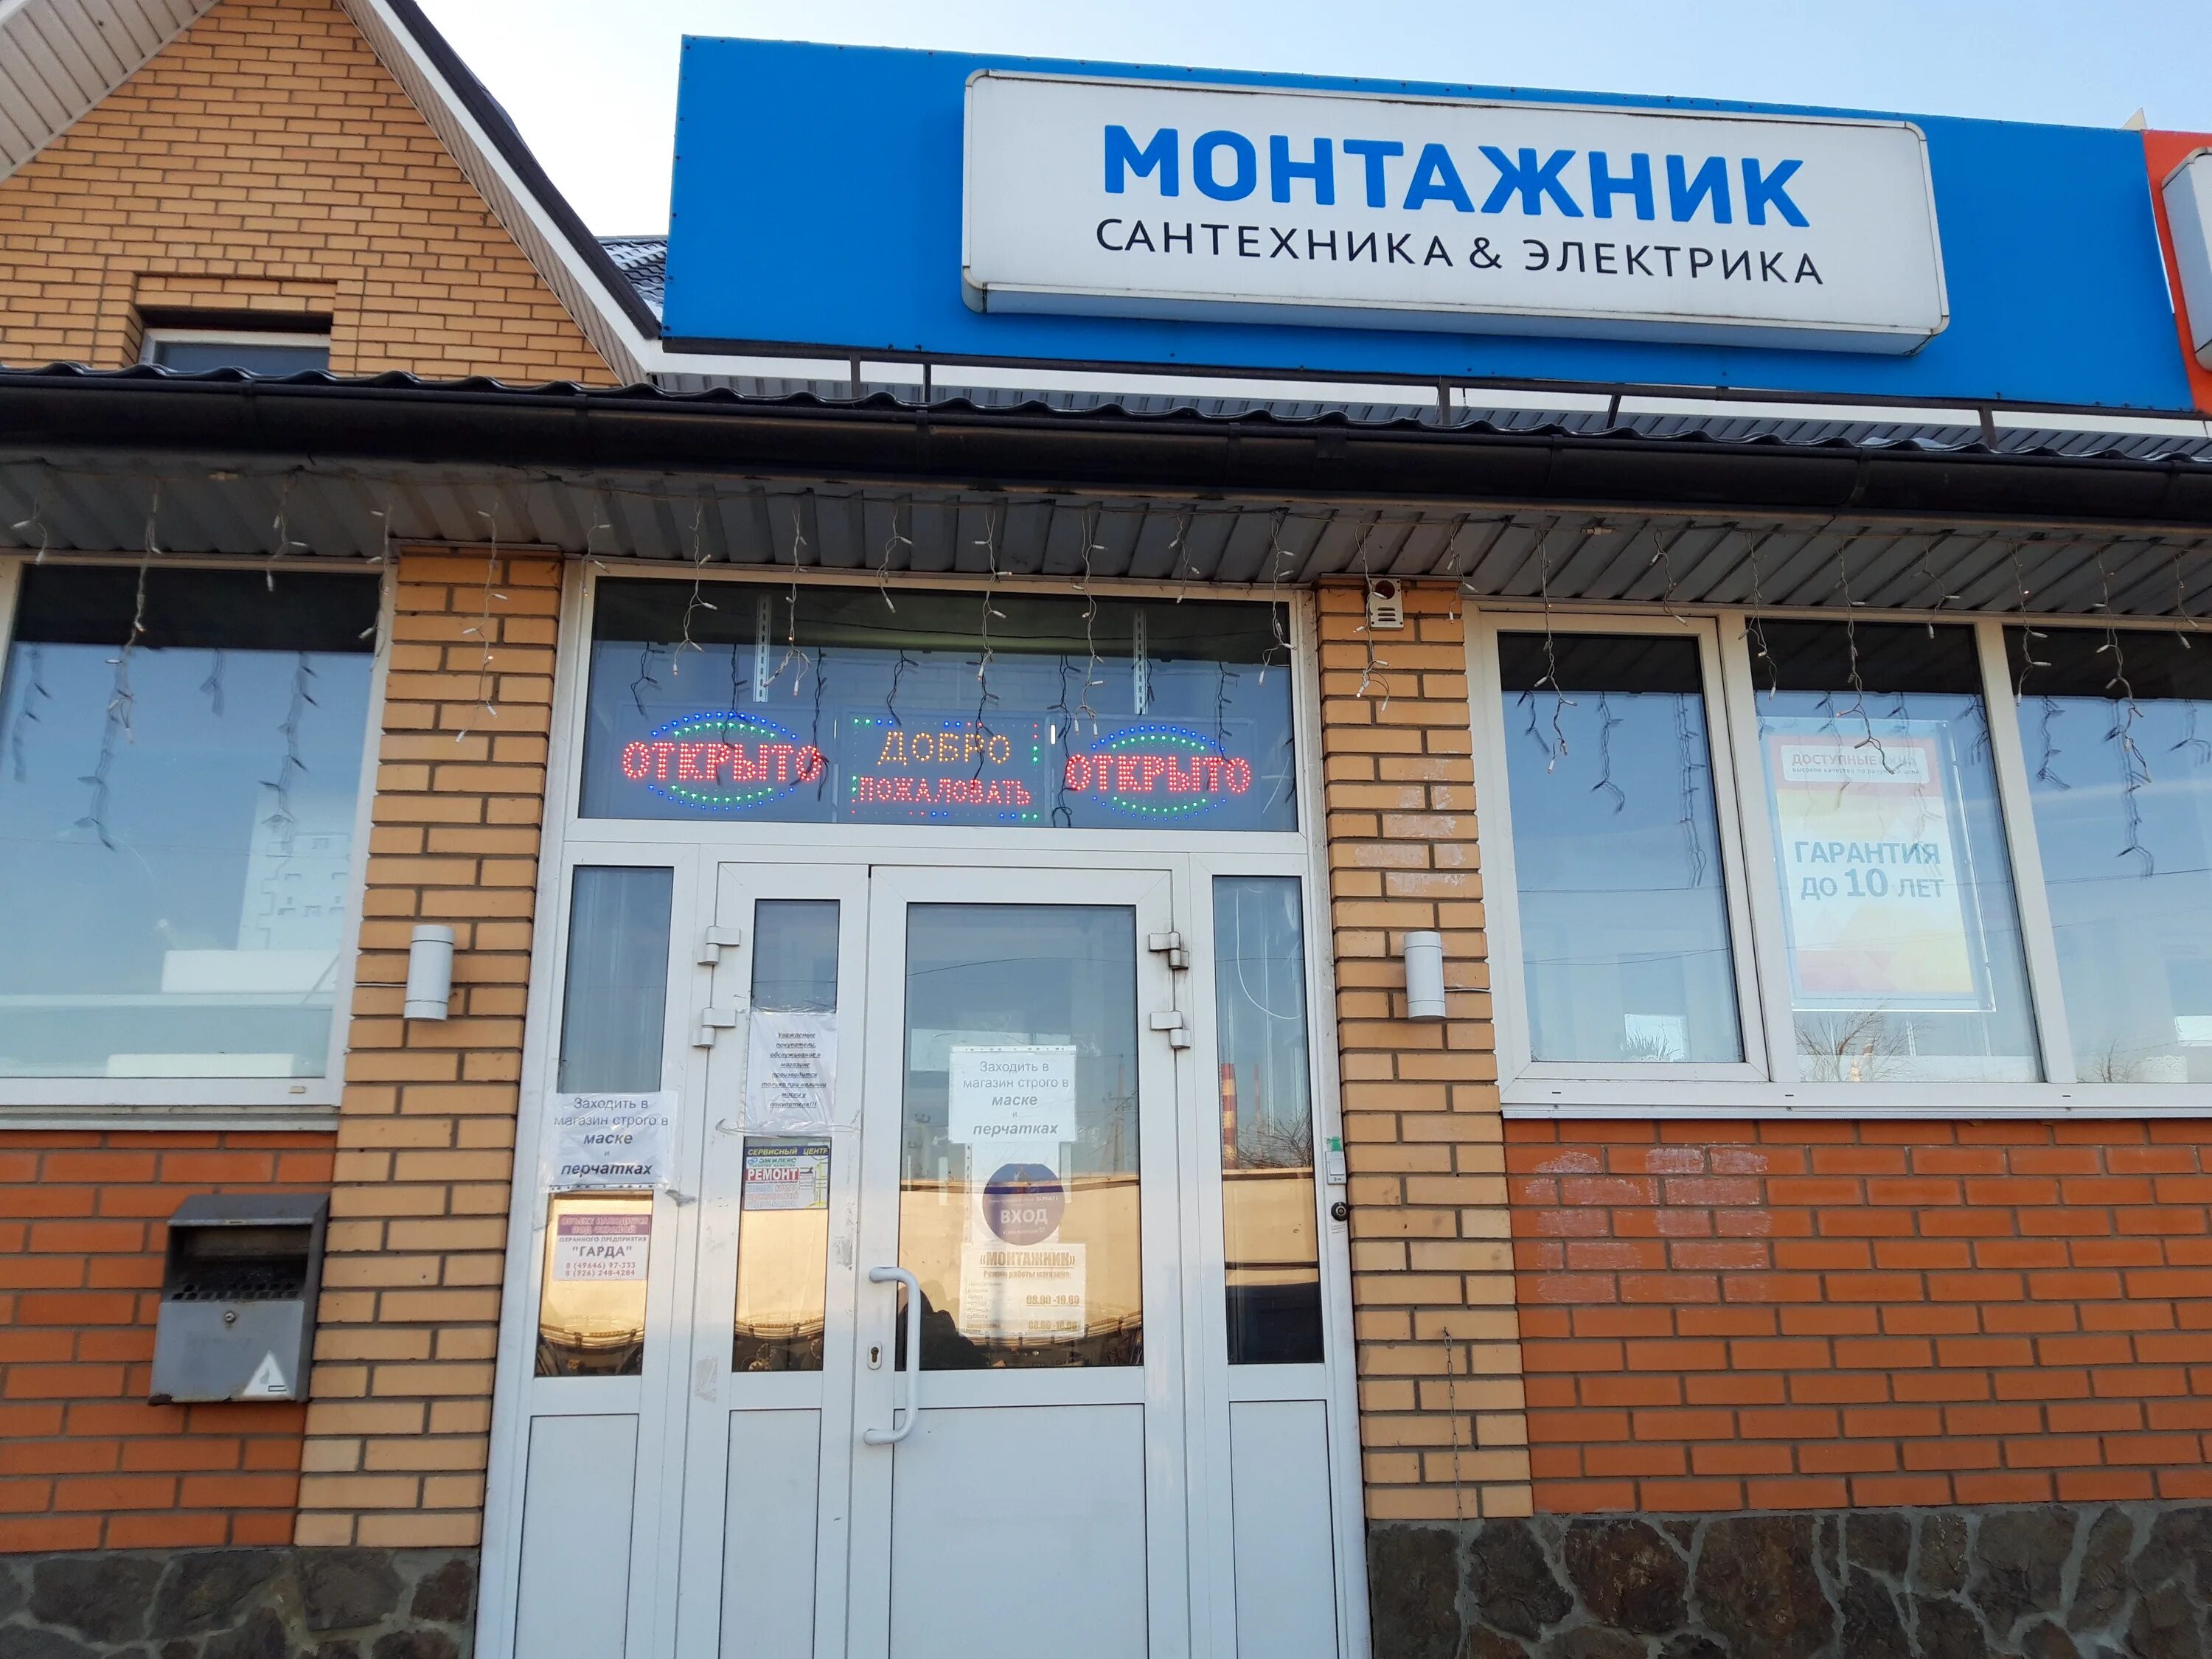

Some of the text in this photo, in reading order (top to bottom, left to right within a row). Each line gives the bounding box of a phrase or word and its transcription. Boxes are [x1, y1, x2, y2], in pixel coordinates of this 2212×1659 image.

[1105, 124, 1810, 228] МОНТАЖНИК
[1096, 218, 1823, 285] САНТЕХНИКА & ЭЛЕКТРИКА
[876, 730, 1011, 766] ДОБРО
[622, 740, 823, 782] ОТКРЫТО
[1792, 754, 1877, 766] ДОСТУПНЫЕ
[1065, 753, 1252, 793] ОТКРЫТО
[858, 776, 1031, 806] ПОЖАЛОВАТЬ
[1795, 841, 1941, 865] ГАРАНТИЯ
[1801, 868, 1945, 901] ДО 10 ЛЕТ
[979, 1060, 1050, 1074] Заходить в
[963, 1079, 1070, 1090] магазин строго в
[573, 1097, 649, 1111] Заходить в
[991, 1096, 1039, 1107] маске
[554, 1116, 669, 1127] магазин строго в
[973, 1124, 1060, 1138] перчатках
[582, 1133, 633, 1145] маске
[748, 1147, 798, 1155] СЕРВИСНЫЙ
[560, 1164, 653, 1178] перчатках
[747, 1168, 798, 1180] РЕМОНТ
[1000, 1208, 1048, 1225] ВХОД
[572, 1245, 633, 1258] "ГАРДА"
[980, 1251, 1076, 1266] «МОНТАЖНИК»
[1009, 1270, 1035, 1279] работы
